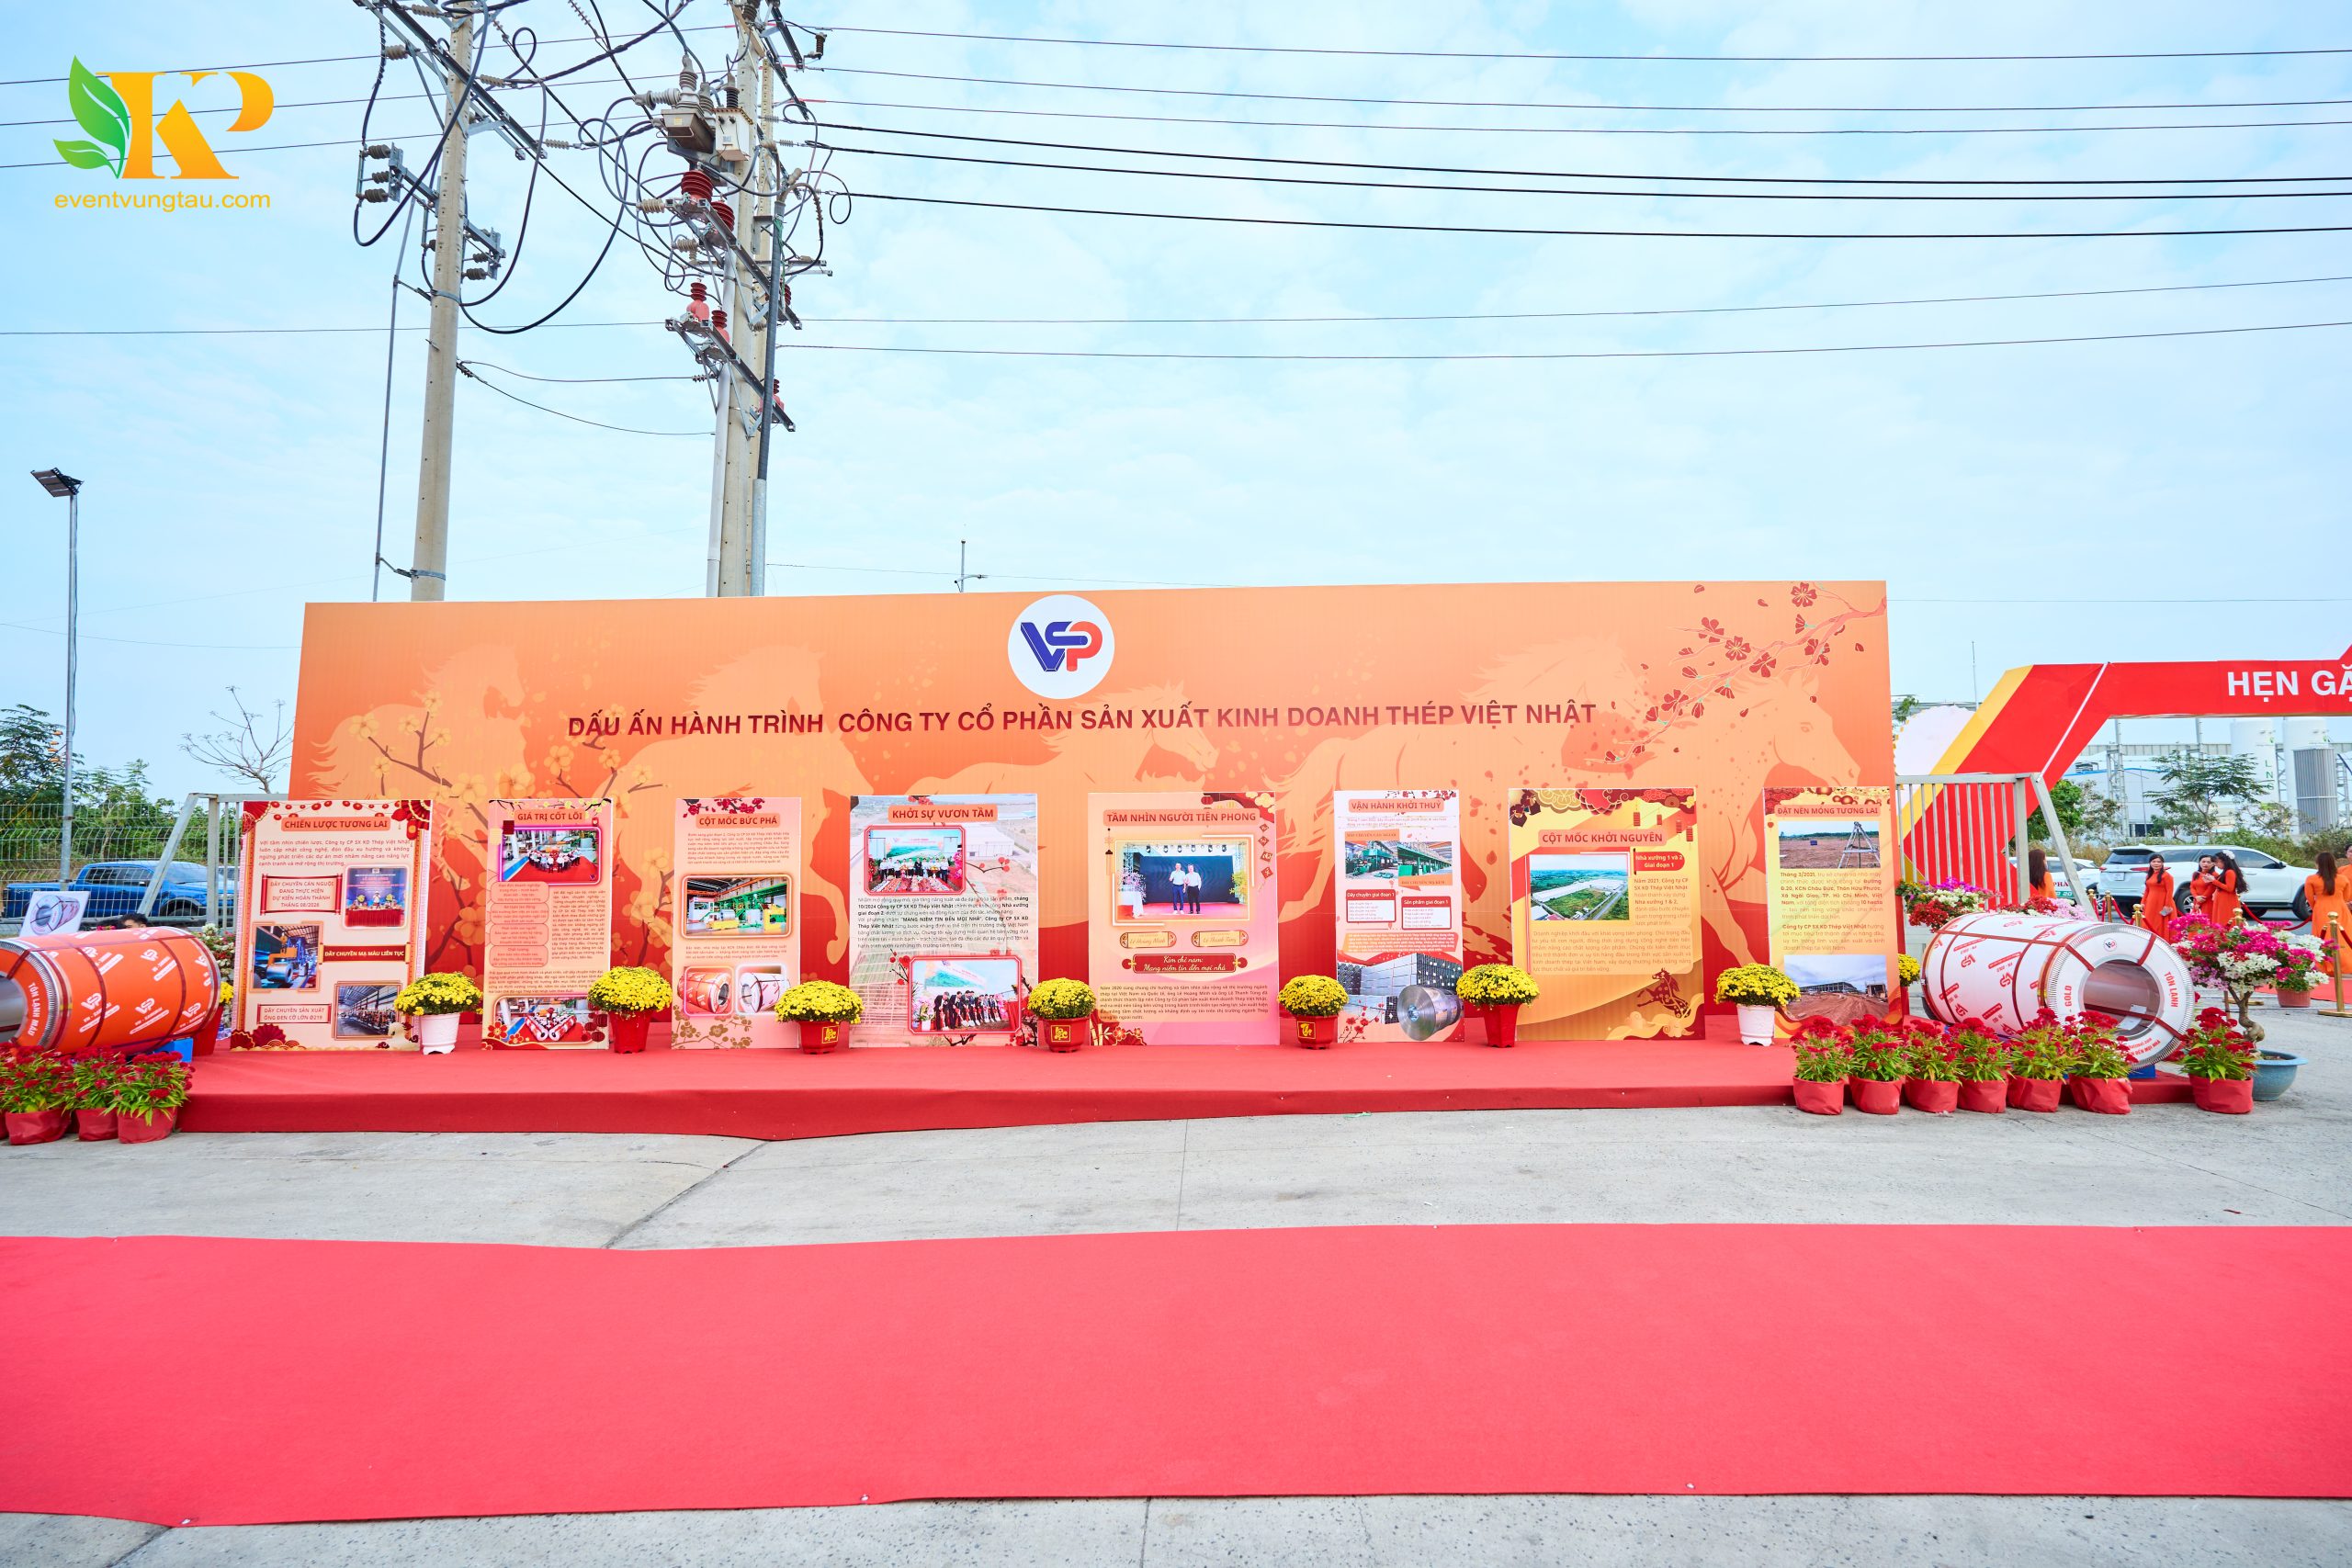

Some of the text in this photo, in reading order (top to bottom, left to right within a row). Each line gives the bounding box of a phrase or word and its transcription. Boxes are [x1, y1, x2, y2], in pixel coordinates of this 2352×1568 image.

[2228, 671, 2298, 703] HẸN
[569, 699, 1596, 738] DẤU ẤN HÀNH TRÌNH CÔNG TY CỔ PHẦN SẢN XUẤT KINH DOANH THÉP VIỆT NHẬT
[699, 817, 716, 826] CỘT
[921, 810, 935, 820] SỰ
[937, 810, 969, 818] VƯƠN
[972, 808, 993, 817] TẦM
[1107, 813, 1127, 822] TẦM
[1196, 812, 1218, 821] TIÊN
[1543, 833, 1561, 844] CỘT
[1565, 833, 1588, 842] MỐC
[1620, 832, 1662, 842] NGUYÊN
[2164, 971, 2179, 1008] TÔN LẠNH
[28, 982, 40, 1037] TÔN LẠNH MÀU
